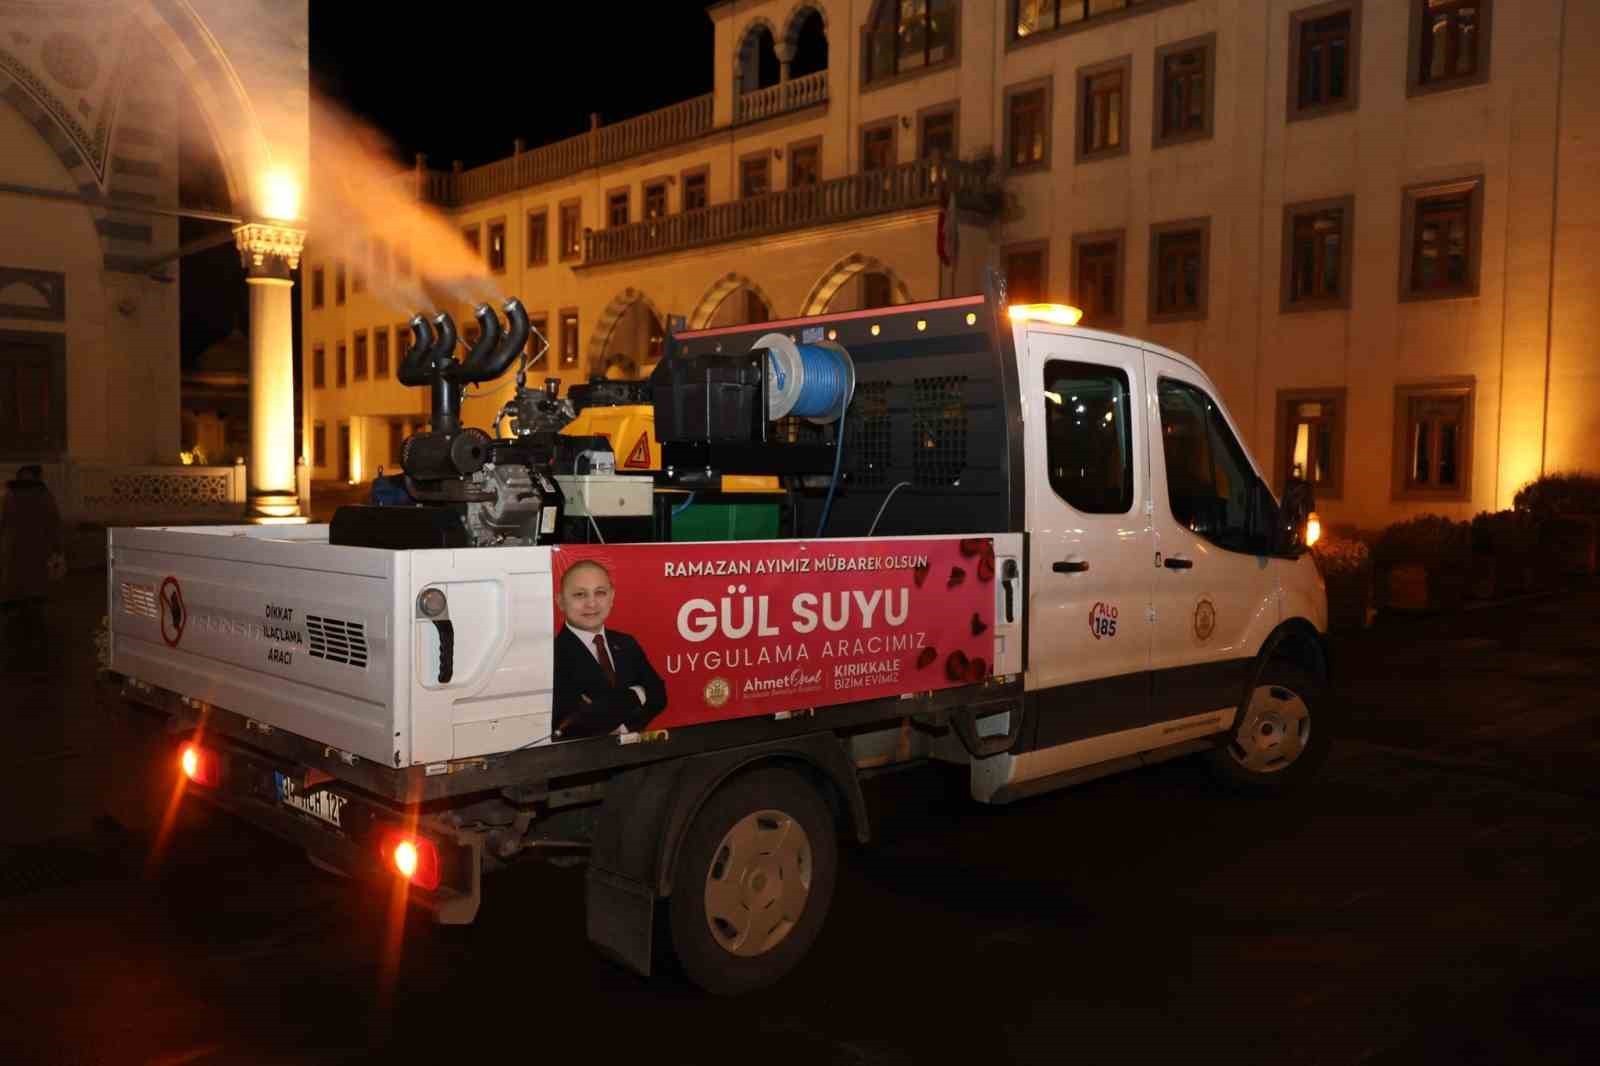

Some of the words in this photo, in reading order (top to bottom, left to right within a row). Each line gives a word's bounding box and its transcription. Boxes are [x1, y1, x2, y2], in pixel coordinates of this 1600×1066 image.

[664, 560, 750, 577] RAMAZAN
[755, 558, 810, 574] AYIMIZ
[814, 553, 881, 572] MÜBAREK
[885, 555, 927, 569] OLSUN
[677, 584, 780, 642] GÜL
[791, 588, 909, 634] SUYU
[1095, 616, 1117, 637] 185
[666, 643, 809, 674] UYGULAMA
[821, 632, 927, 658] ARACIMIZ
[834, 658, 900, 678] KIRIKKALE
[743, 675, 789, 692] Ahmet
